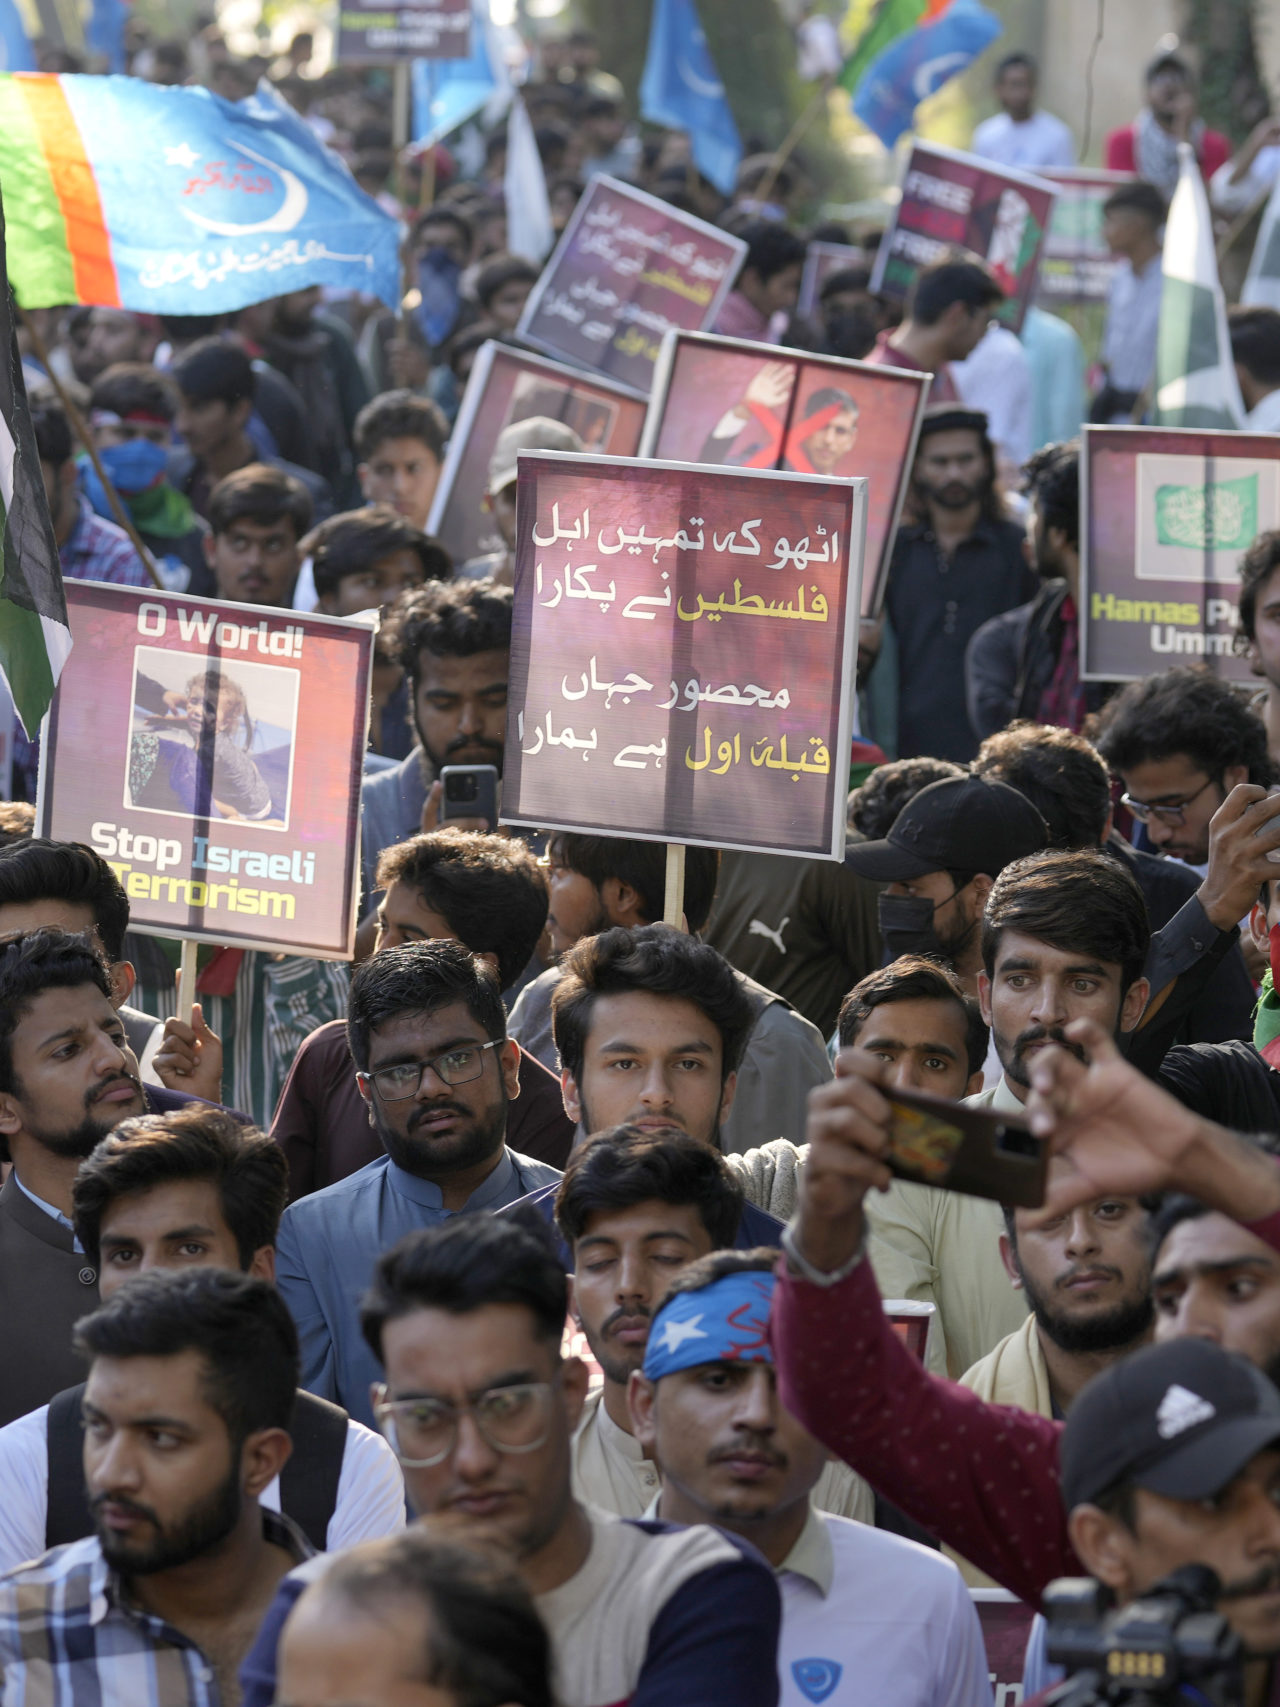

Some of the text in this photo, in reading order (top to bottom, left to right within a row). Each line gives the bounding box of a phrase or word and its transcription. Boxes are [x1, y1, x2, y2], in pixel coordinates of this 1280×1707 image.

[531, 502, 839, 571] اٹھو کہ تمہیں اہل
[536, 562, 616, 613] پکارا
[621, 570, 672, 620] نے
[1091, 592, 1201, 626] Hamas
[136, 602, 305, 659] O World!
[561, 655, 791, 712] محصور جہاں
[517, 709, 598, 762] ہمارا
[612, 735, 668, 770] ہے
[684, 726, 741, 775] اول
[91, 821, 317, 885] Stop Israeli
[105, 861, 296, 921] Terrorism
